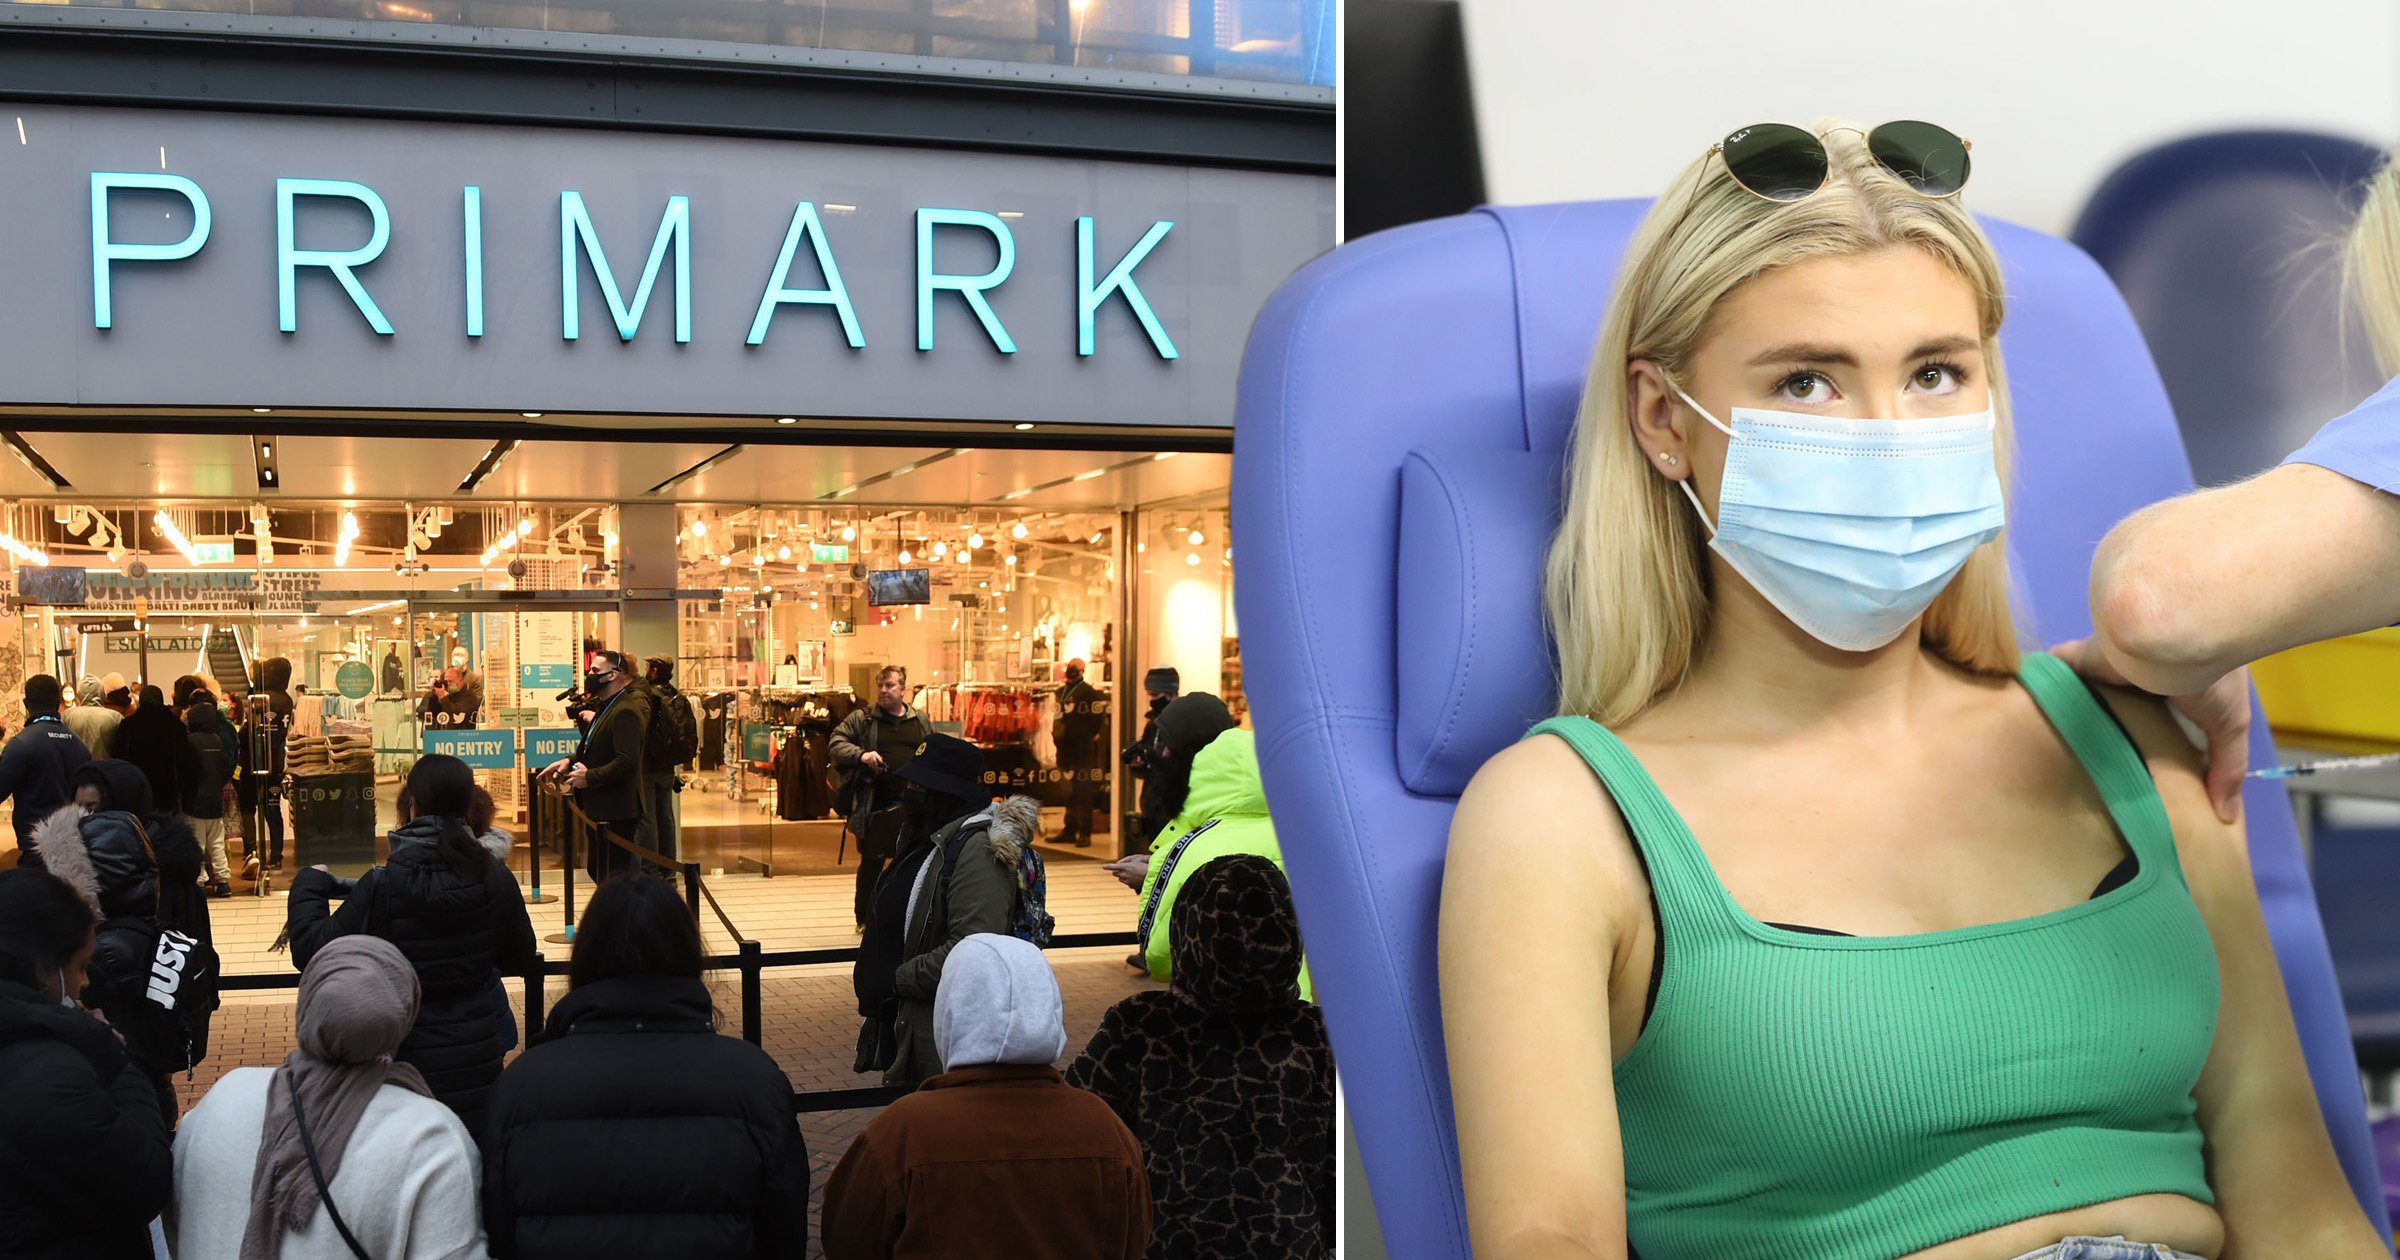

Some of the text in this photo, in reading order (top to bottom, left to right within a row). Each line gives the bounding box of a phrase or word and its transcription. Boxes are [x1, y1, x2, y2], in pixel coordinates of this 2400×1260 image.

[90, 171, 1179, 361] PRIMARK
[263, 580, 320, 592] STREET
[47, 732, 73, 740] SECURITY
[435, 741, 503, 756] NO ENTRY
[536, 739, 580, 755] NO ENT
[1161, 858, 1175, 879] ONS
[1149, 888, 1161, 909] ONS
